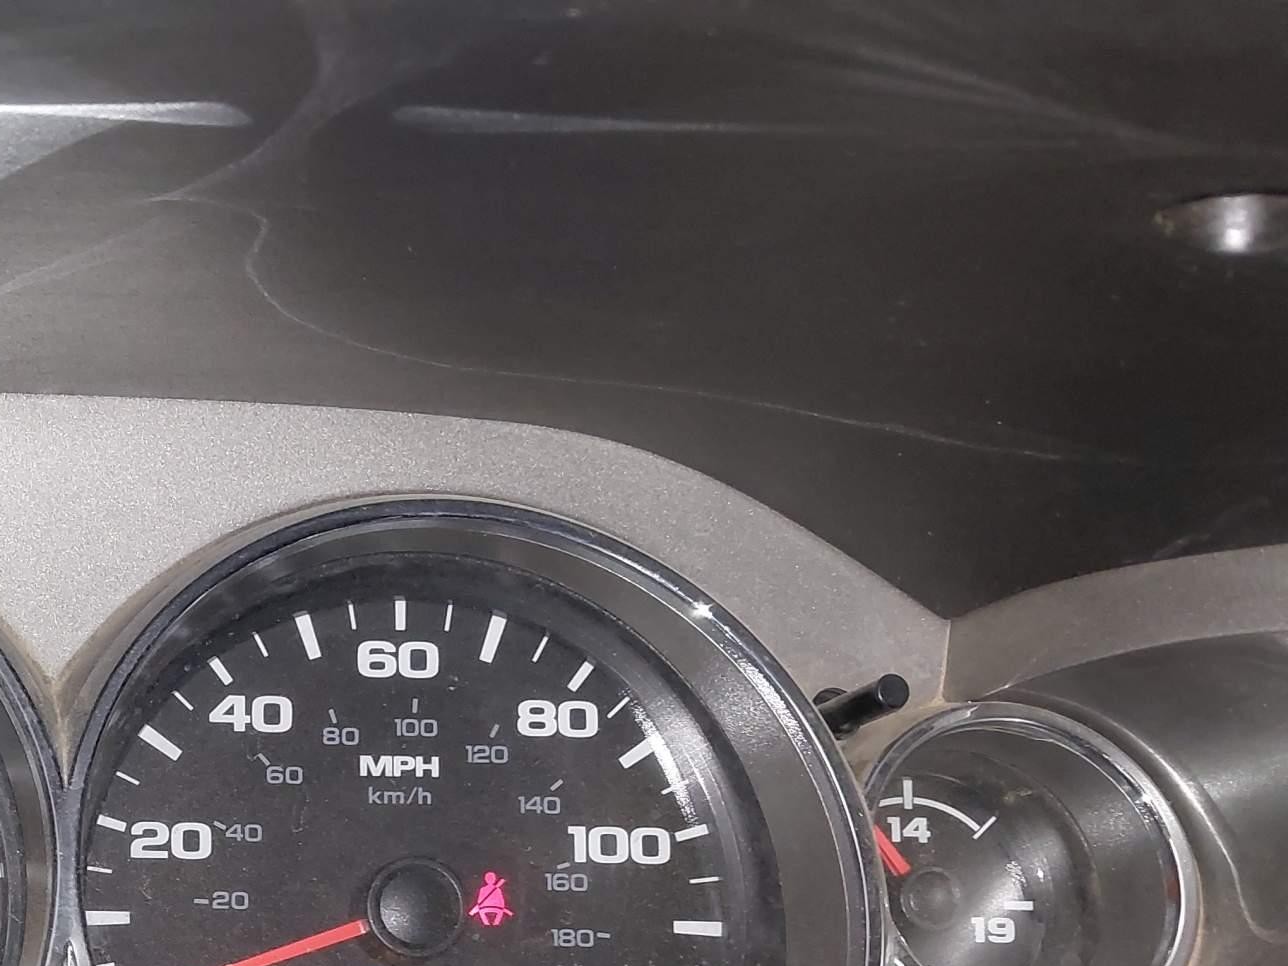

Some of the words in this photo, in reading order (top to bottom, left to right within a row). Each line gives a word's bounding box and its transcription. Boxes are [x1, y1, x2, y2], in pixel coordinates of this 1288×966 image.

[357, 640, 440, 679] 60
[209, 694, 293, 733] 40
[516, 699, 599, 738] 80
[322, 727, 360, 746] 80
[394, 718, 438, 737] 100
[465, 745, 509, 764] 120
[266, 766, 304, 785] 60
[359, 755, 440, 778] MPH
[368, 786, 433, 806] km/h
[517, 796, 561, 815] 140
[225, 823, 263, 843] 40
[887, 816, 931, 844] 14
[130, 821, 212, 860] 20
[567, 825, 671, 865] 100
[544, 873, 589, 893] 160
[212, 891, 250, 910] 20
[550, 928, 595, 948] 180
[971, 916, 1016, 944] 19
